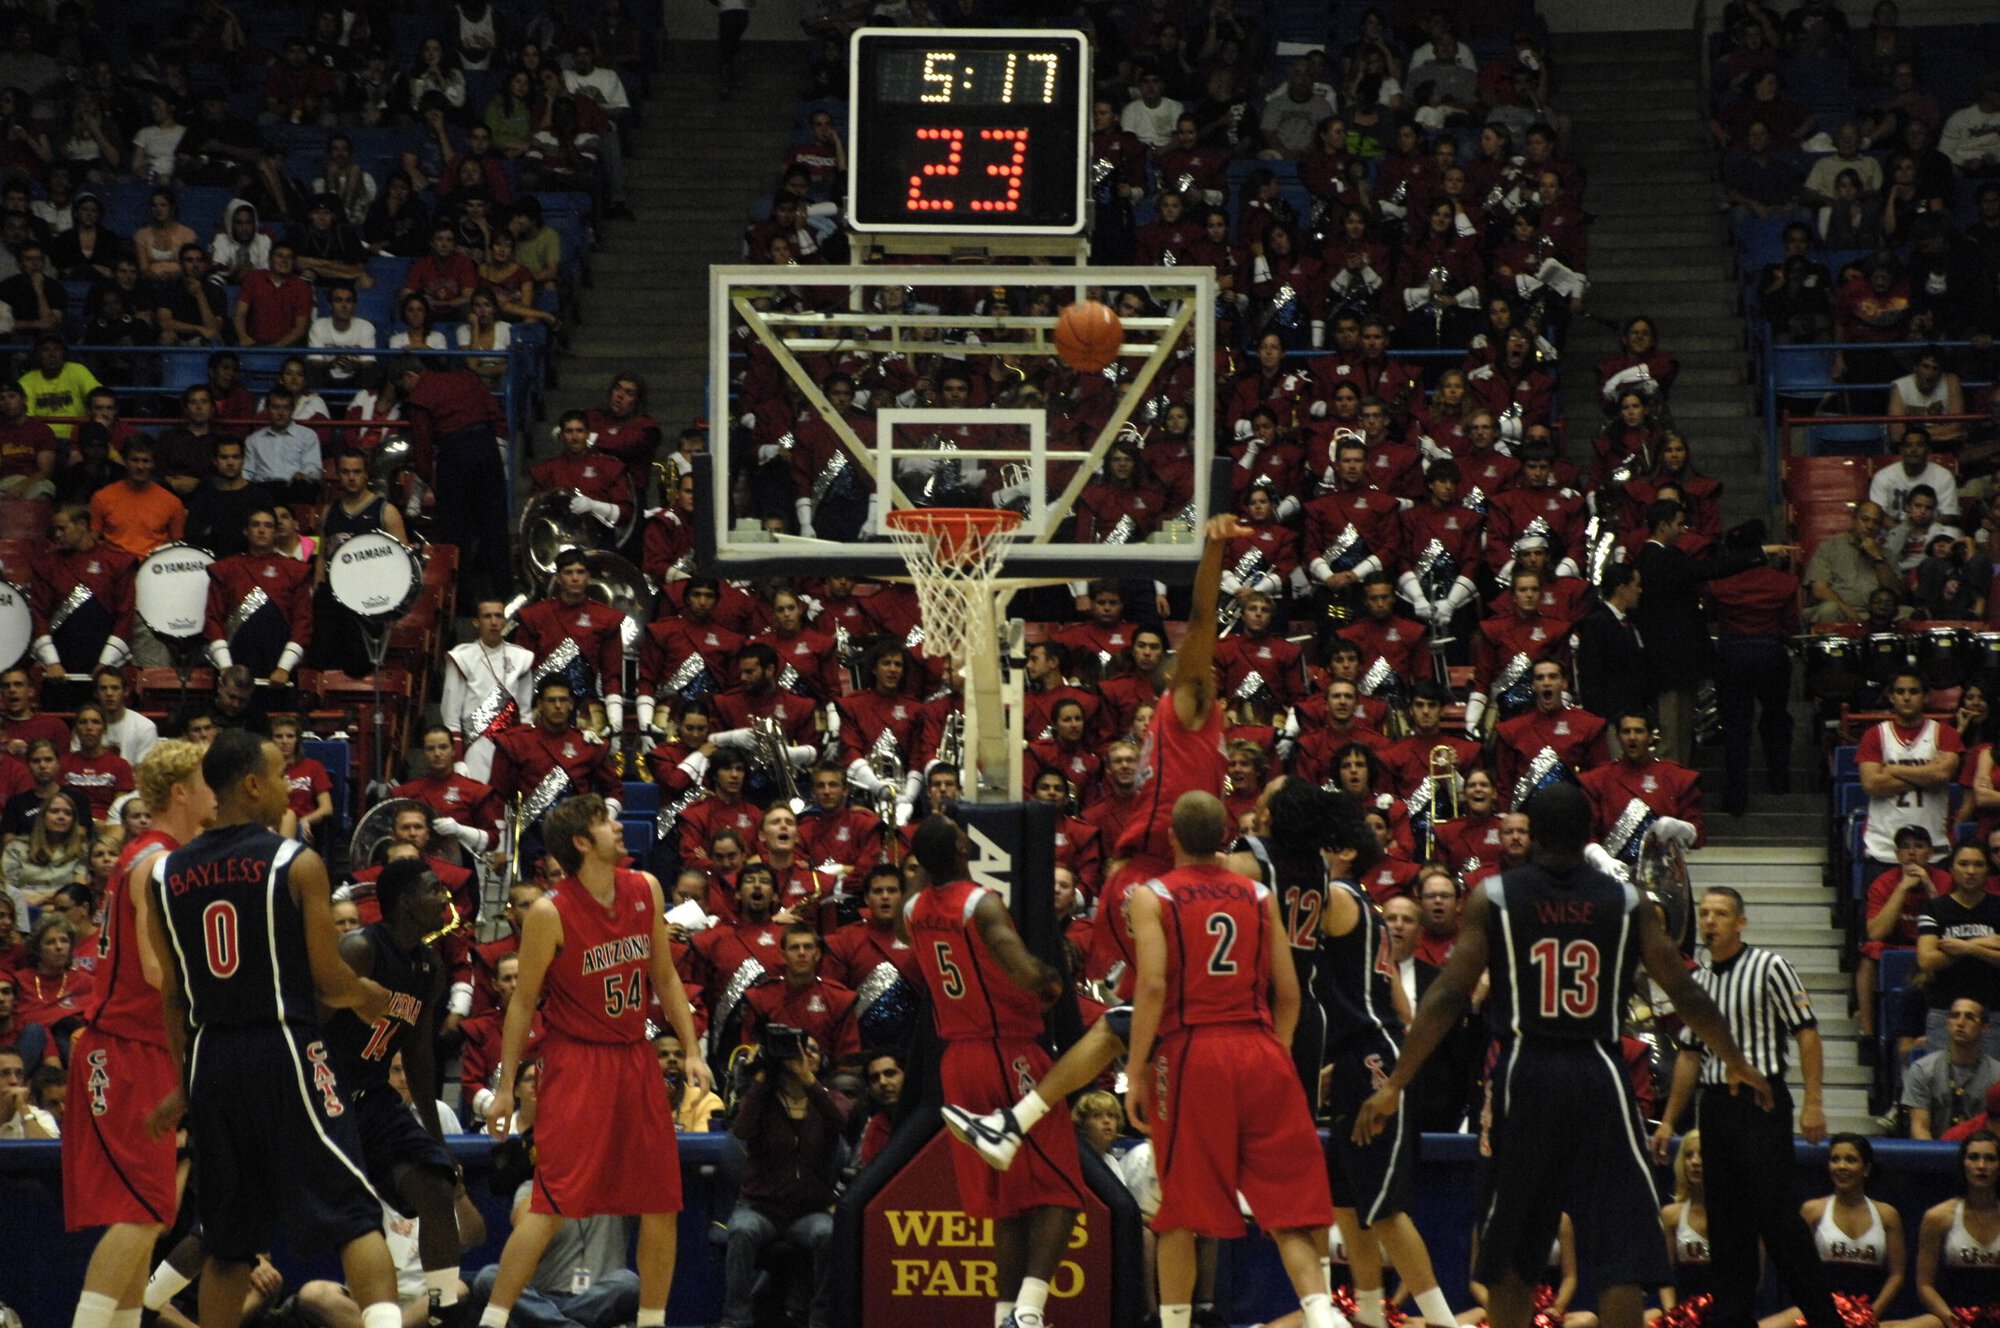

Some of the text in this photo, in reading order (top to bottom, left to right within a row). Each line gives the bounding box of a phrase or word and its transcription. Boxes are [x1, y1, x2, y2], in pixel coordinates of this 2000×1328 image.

[921, 53, 1058, 104] 5:17
[907, 128, 1028, 212] 23
[164, 561, 207, 573] YAMAHA
[353, 545, 394, 562] YAMAHA
[167, 858, 267, 897] BAYLESS
[203, 899, 240, 980] 0
[1285, 886, 1322, 951] 12
[1535, 901, 1595, 925] WISE
[934, 941, 965, 999] 5
[1206, 912, 1238, 976] 2
[604, 968, 641, 1018] 54
[1530, 937, 1600, 1019] 13
[87, 1049, 110, 1115] CATS
[306, 1040, 344, 1117] CATS
[891, 1259, 1086, 1298] FARO
